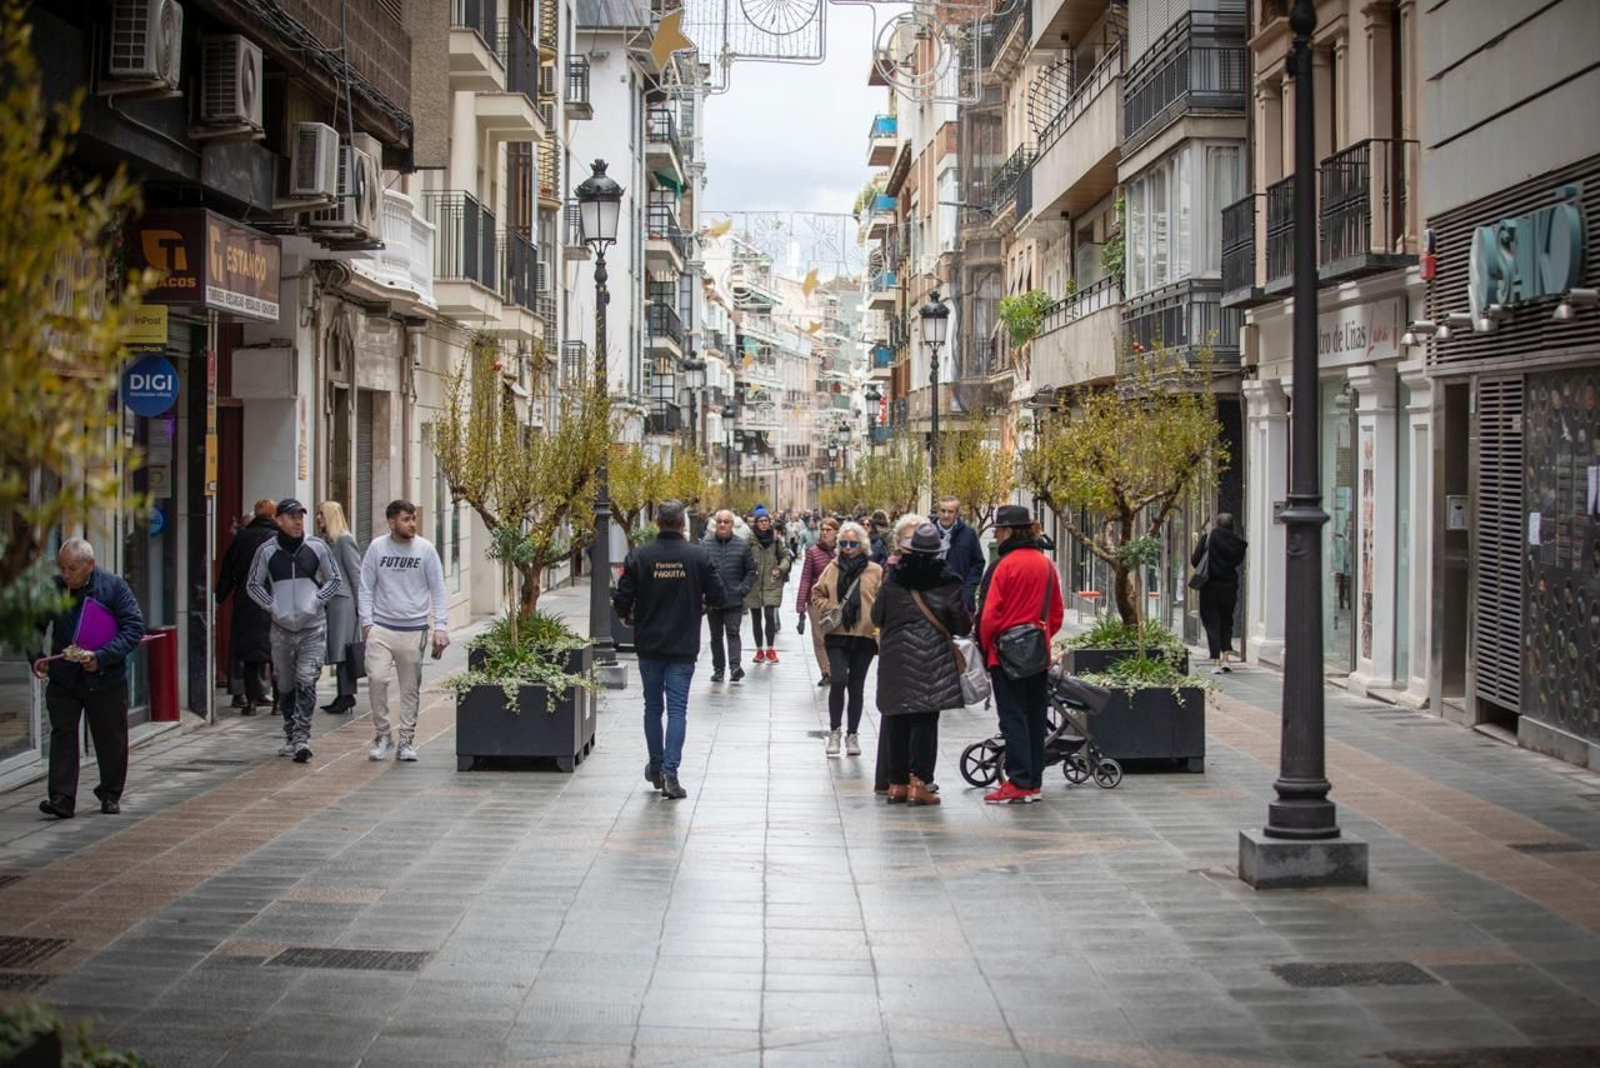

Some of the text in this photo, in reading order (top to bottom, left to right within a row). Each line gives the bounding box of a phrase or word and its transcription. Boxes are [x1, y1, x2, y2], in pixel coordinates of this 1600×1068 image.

[226, 244, 267, 281] ESTANCO
[1333, 323, 1343, 353] de
[129, 374, 173, 391] DIGI
[379, 555, 422, 569] FUTURE
[653, 569, 686, 579] PAQUITA
